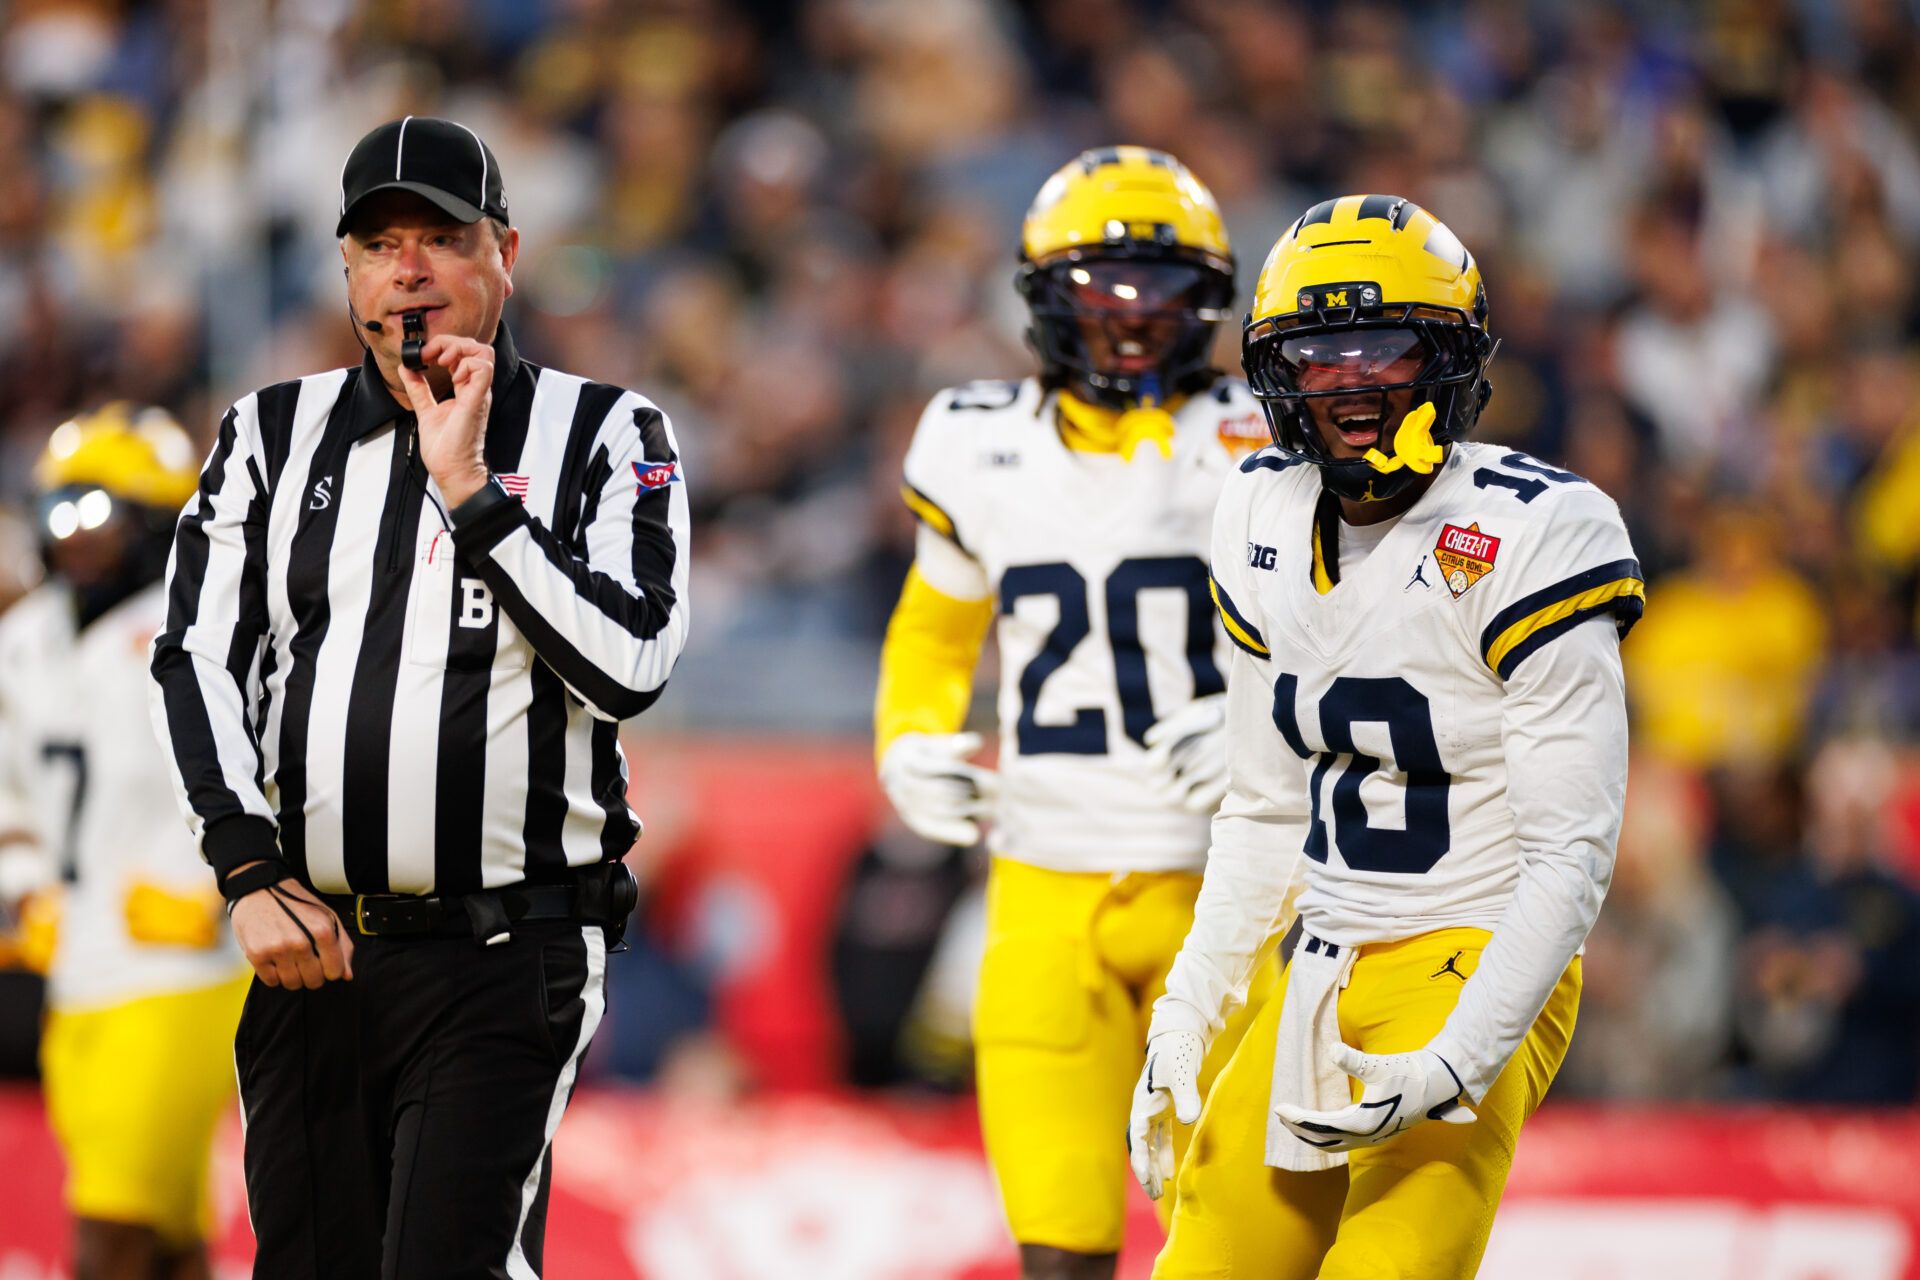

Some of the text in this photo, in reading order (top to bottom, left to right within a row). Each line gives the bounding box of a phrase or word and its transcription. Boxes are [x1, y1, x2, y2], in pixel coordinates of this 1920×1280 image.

[1326, 291, 1348, 307] M
[458, 577, 494, 629] B
[1441, 553, 1483, 572] CITRUS BOWL
[1001, 556, 1227, 755] 20
[40, 740, 87, 883] 7
[1273, 672, 1451, 874] 10
